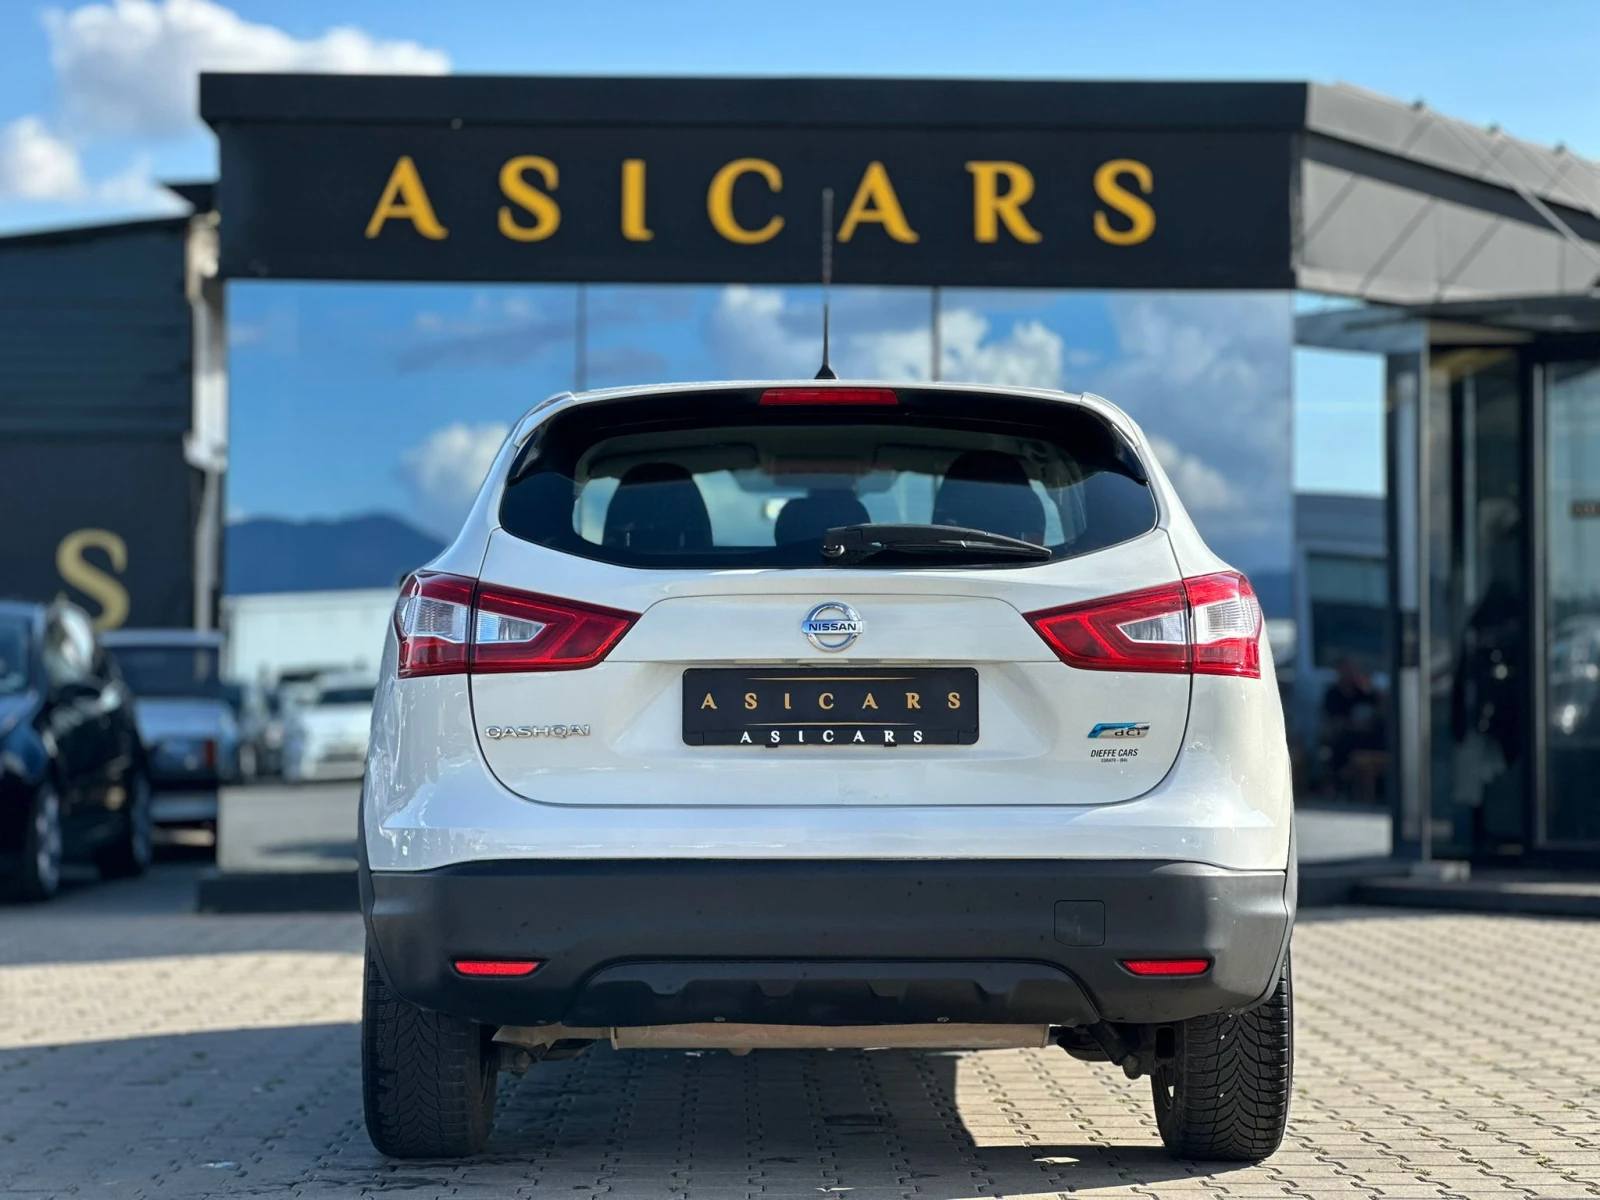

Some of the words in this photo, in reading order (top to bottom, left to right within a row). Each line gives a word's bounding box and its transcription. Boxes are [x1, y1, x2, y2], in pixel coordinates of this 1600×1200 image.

[366, 155, 1156, 246] ASICARS
[808, 623, 857, 631] NISSAN
[701, 692, 961, 709] ASICARS
[485, 725, 590, 740] QASHQAI
[740, 729, 923, 744] ASICARS
[1090, 749, 1117, 757] DIEFFE
[1118, 748, 1139, 757] CARS
